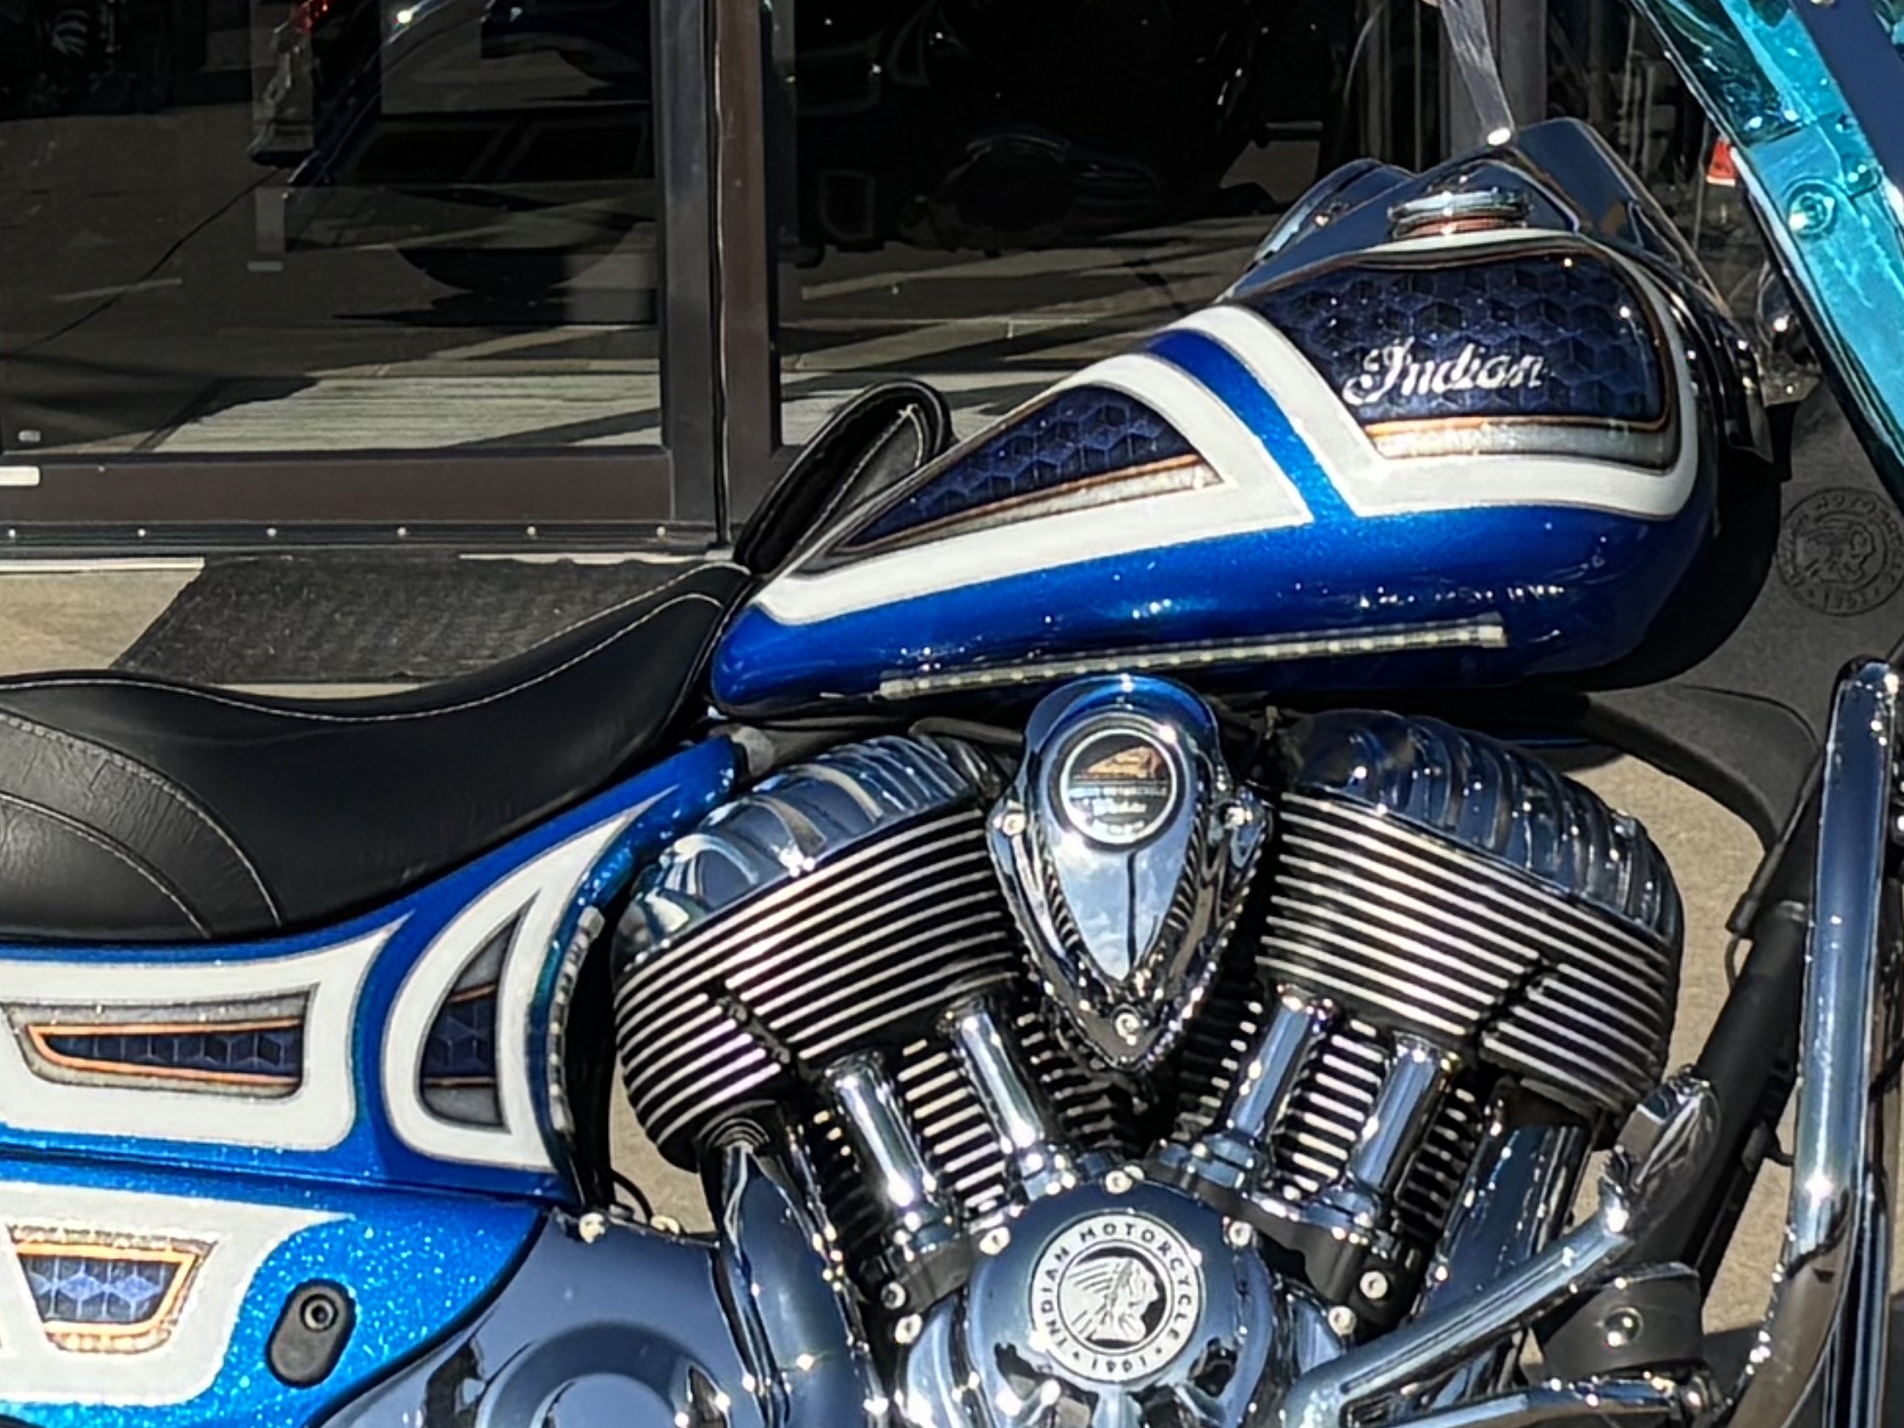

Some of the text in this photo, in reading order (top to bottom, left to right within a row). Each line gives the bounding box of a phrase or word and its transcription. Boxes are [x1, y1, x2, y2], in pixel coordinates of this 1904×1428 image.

[1342, 336, 1545, 406] Indian
[1040, 1222, 1192, 1347] INDIAN MOTORCYCLE
